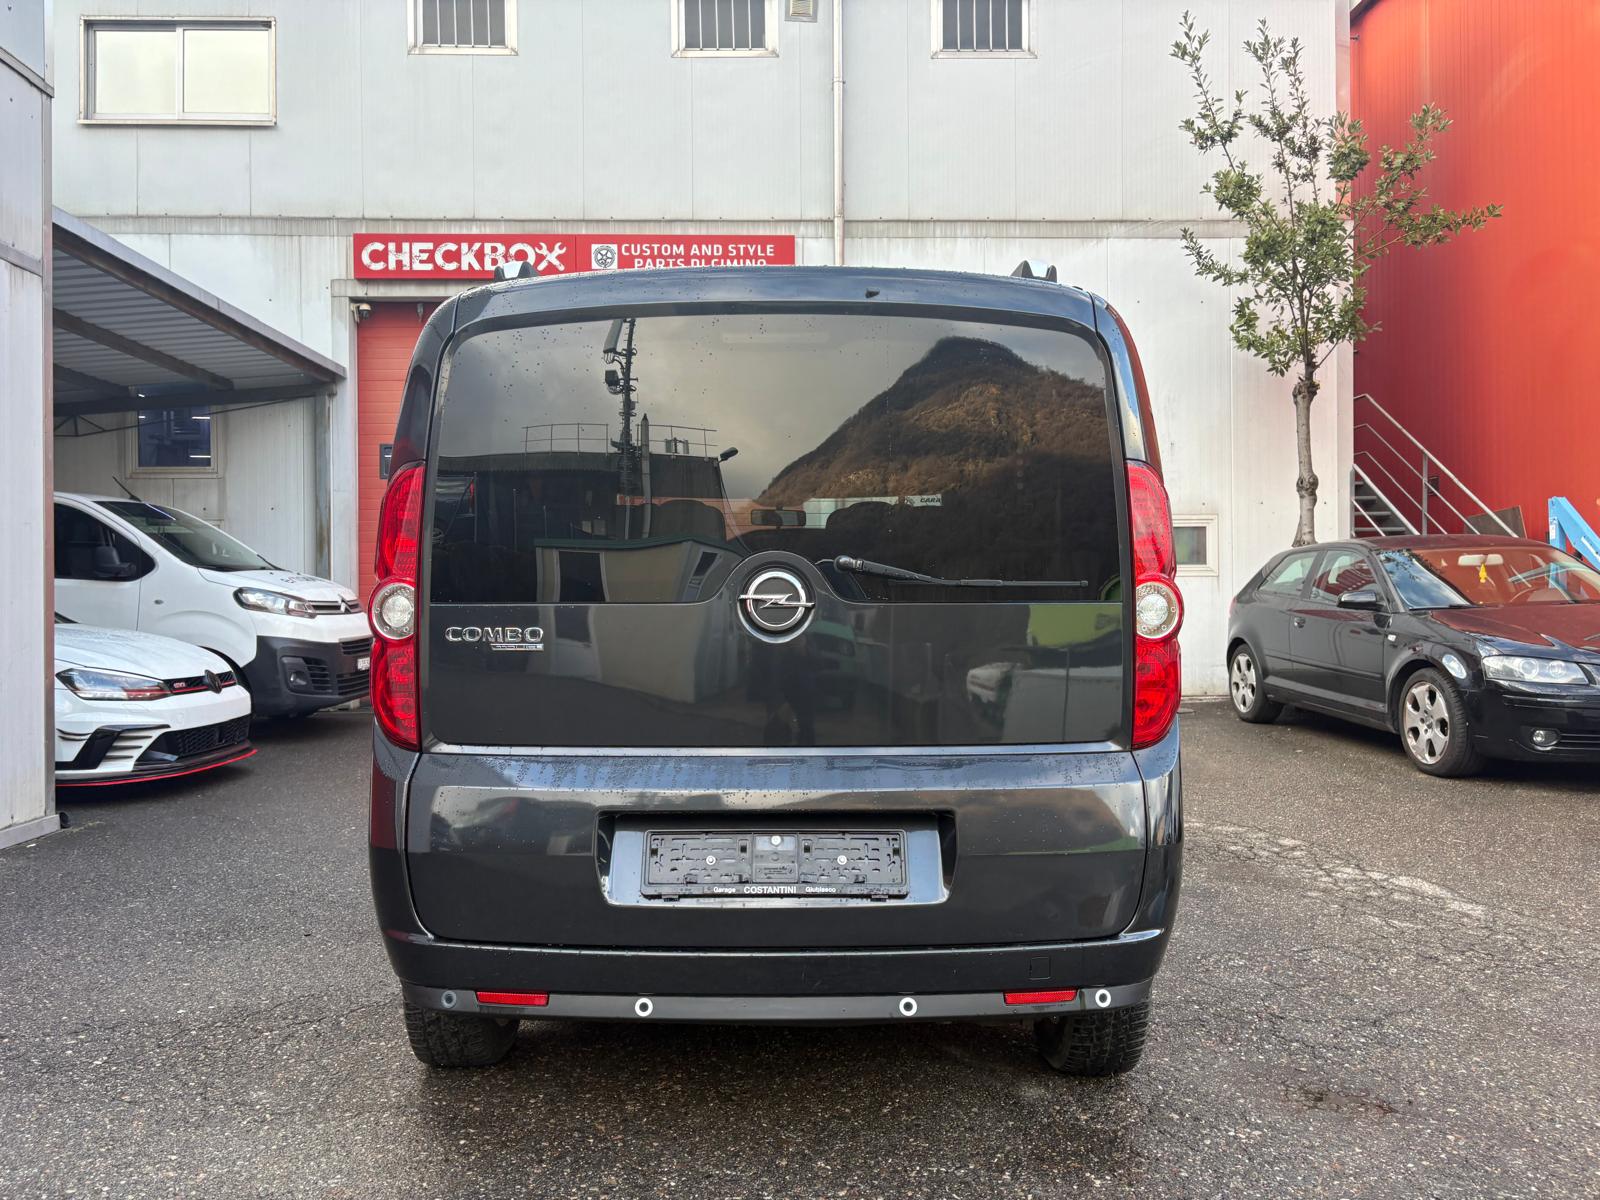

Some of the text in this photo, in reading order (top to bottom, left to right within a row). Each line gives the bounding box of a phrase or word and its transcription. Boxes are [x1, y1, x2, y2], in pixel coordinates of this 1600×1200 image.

[361, 241, 567, 272] CHECKBOX
[621, 243, 775, 257] CUSTOM AND STYLE
[634, 258, 685, 269] PARTS
[445, 626, 544, 642] COMBO
[713, 886, 736, 894] Garage
[743, 885, 797, 894] COSTANTINI
